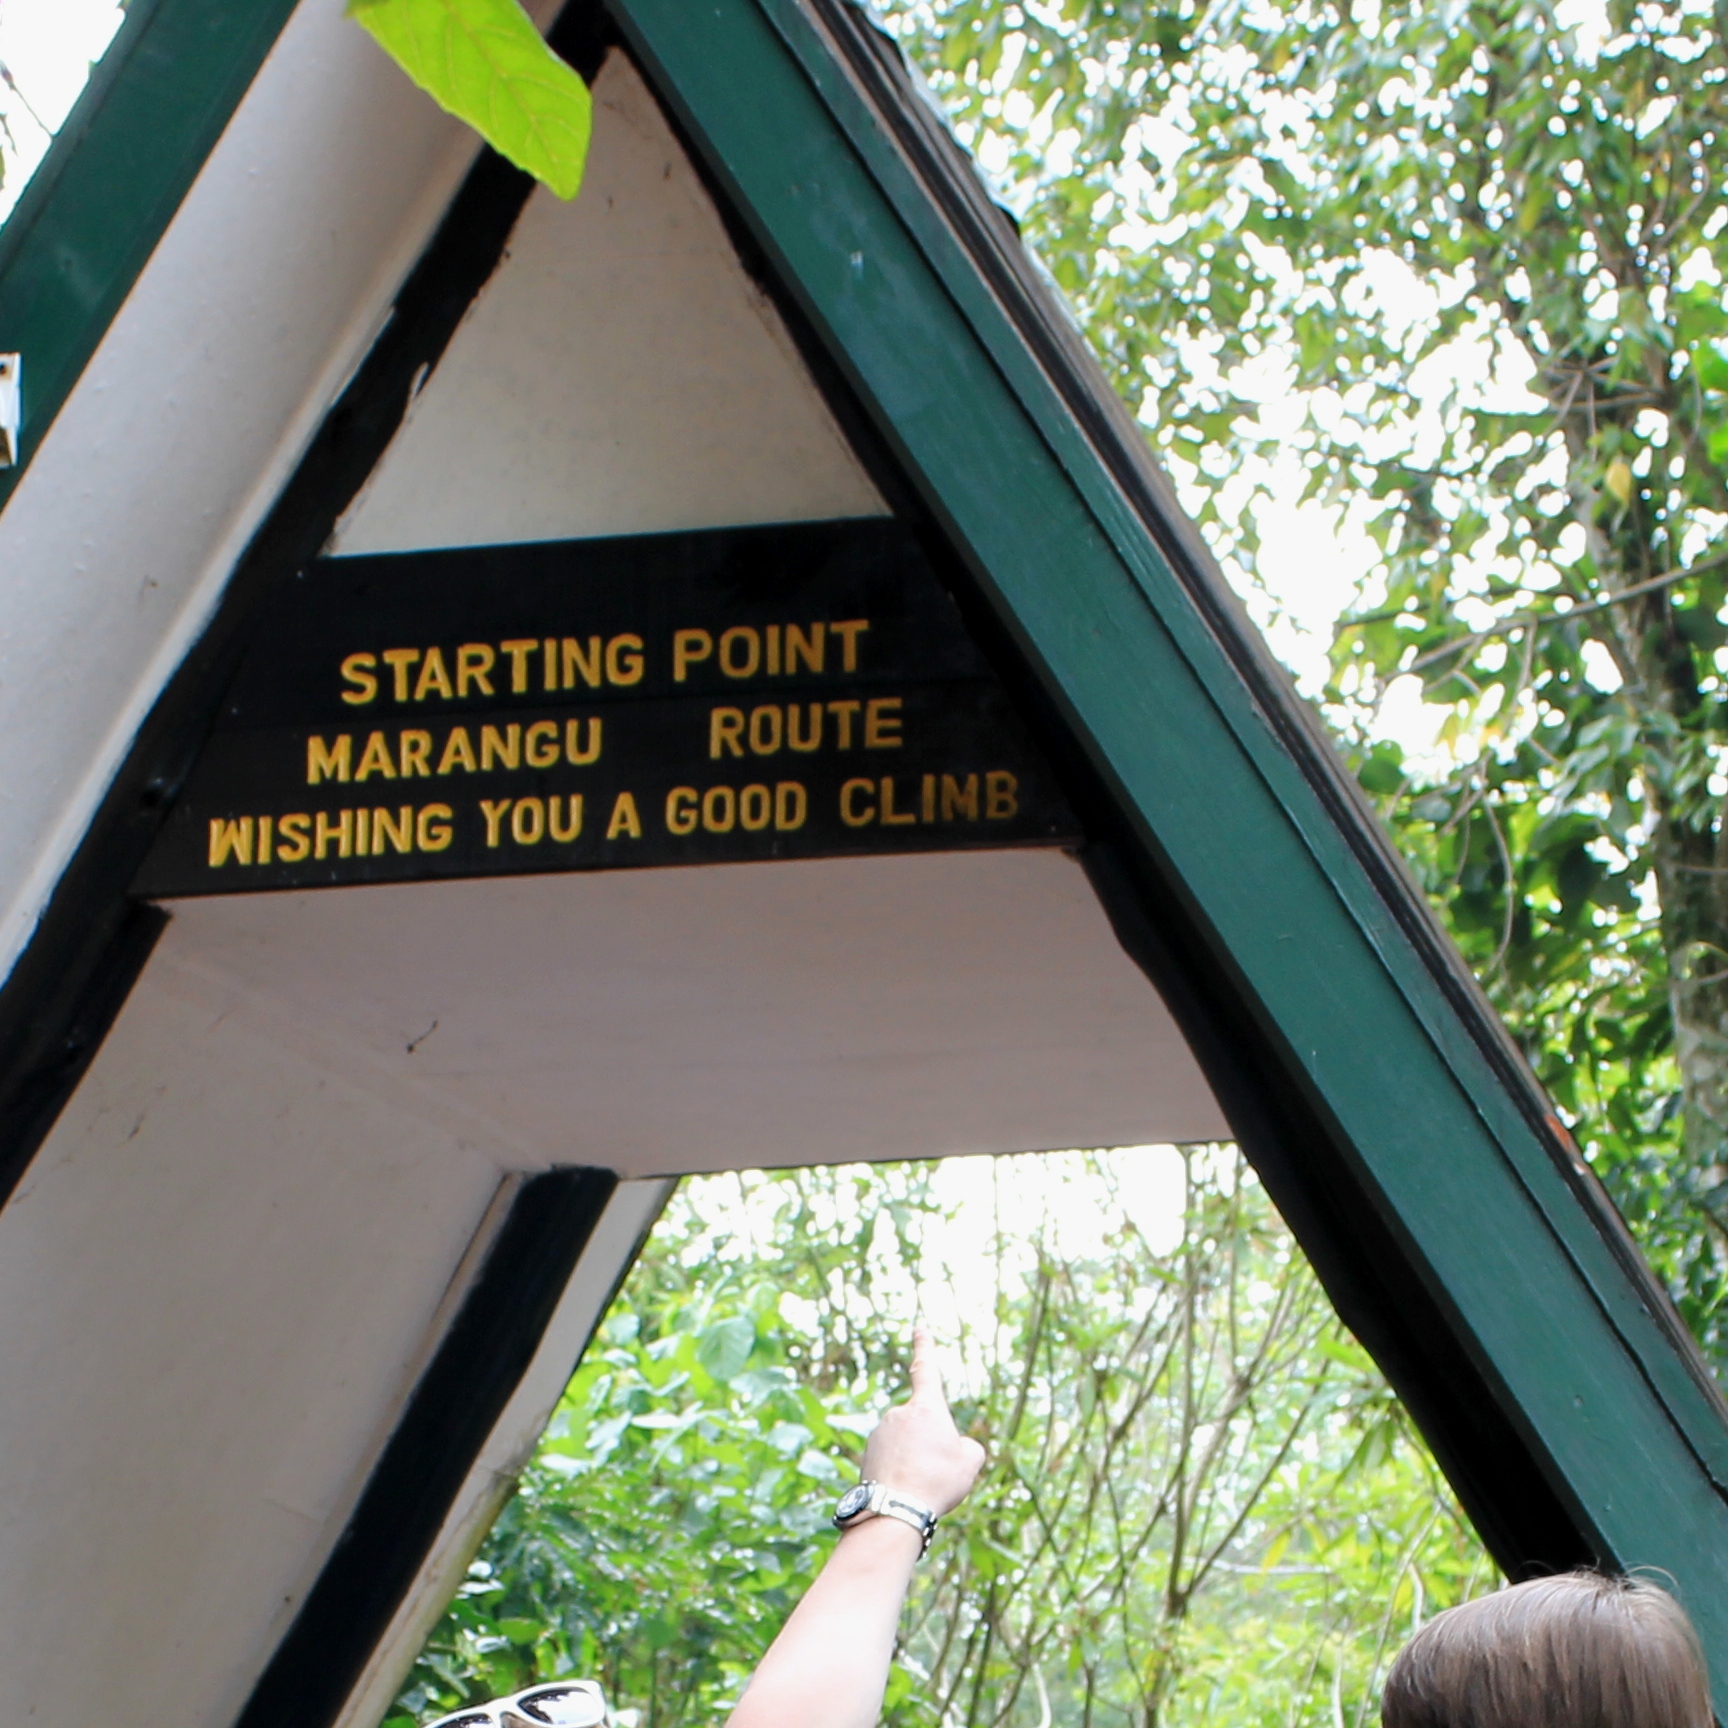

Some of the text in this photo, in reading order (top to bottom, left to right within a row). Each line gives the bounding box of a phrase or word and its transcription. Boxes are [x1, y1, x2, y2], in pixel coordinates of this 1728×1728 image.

[339, 618, 870, 707] STARTING POINT
[305, 697, 904, 785] MARANGU ROUTE
[208, 769, 1019, 868] WISHING YOU A GOOD CLIMB
